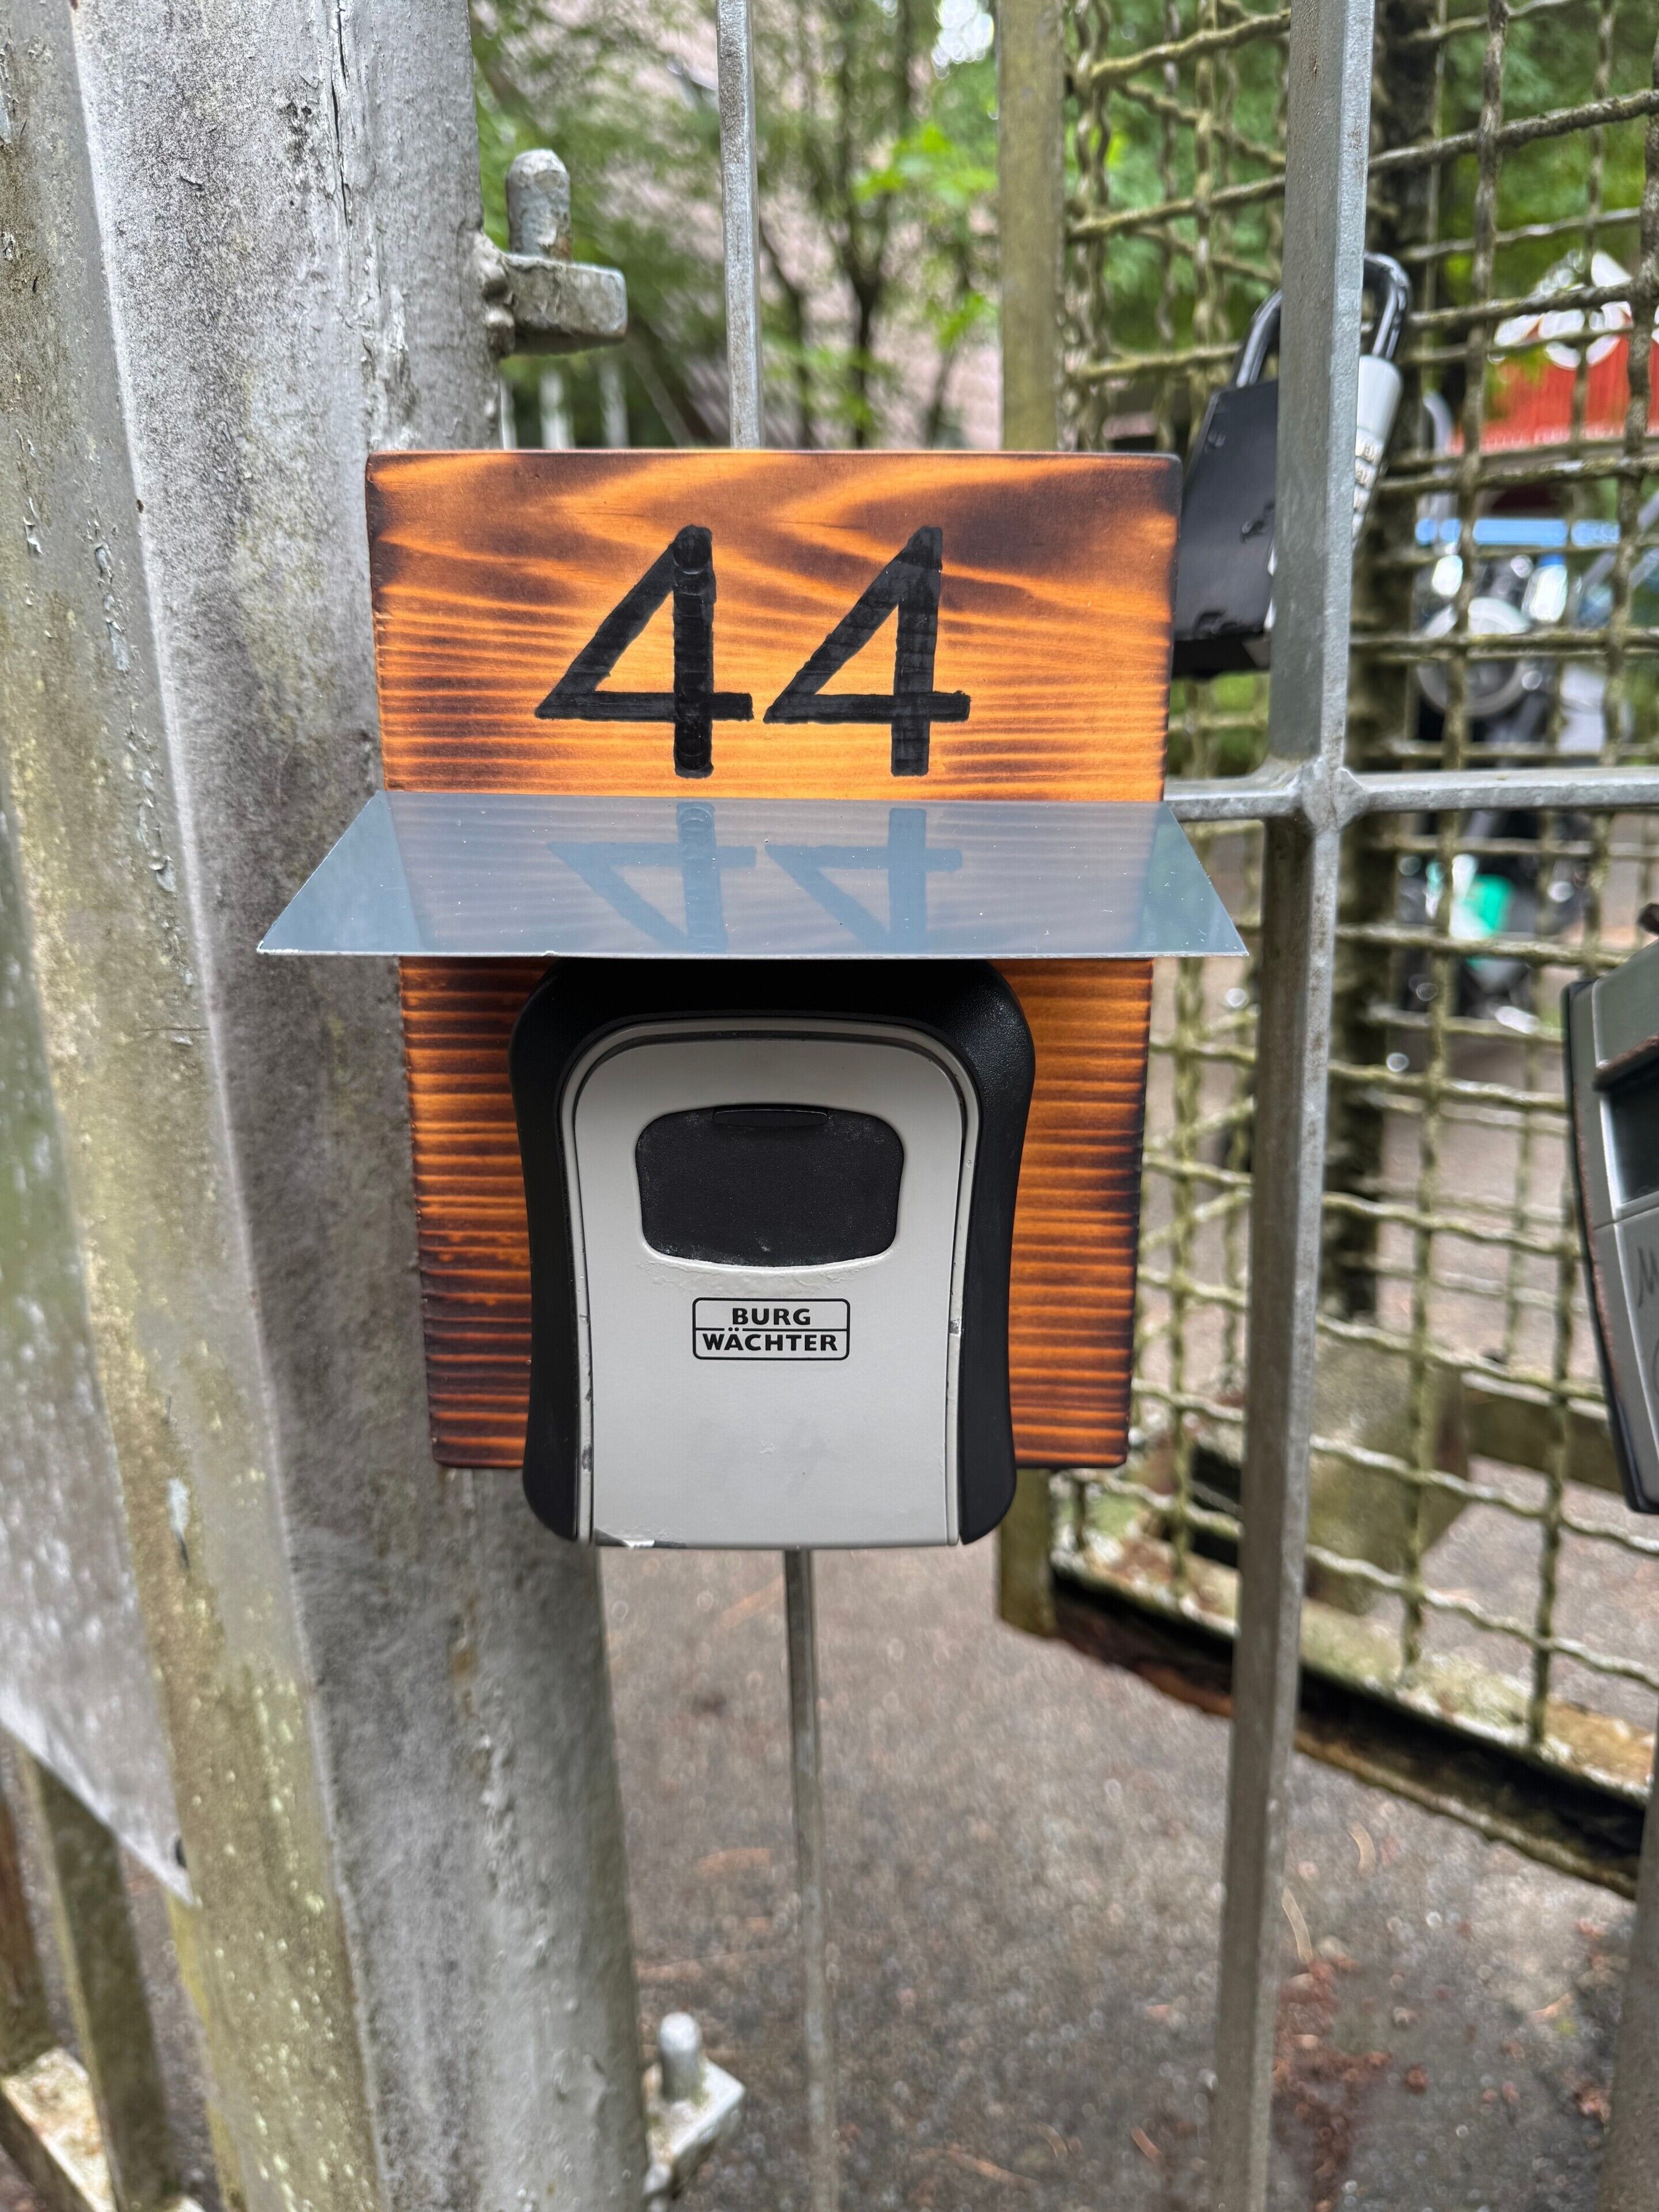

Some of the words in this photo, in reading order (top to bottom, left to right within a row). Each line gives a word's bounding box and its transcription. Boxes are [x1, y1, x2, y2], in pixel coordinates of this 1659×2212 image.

[535, 525, 971, 778] 44
[732, 1307, 810, 1325] BURG
[702, 1327, 838, 1351] WÄCHTER
